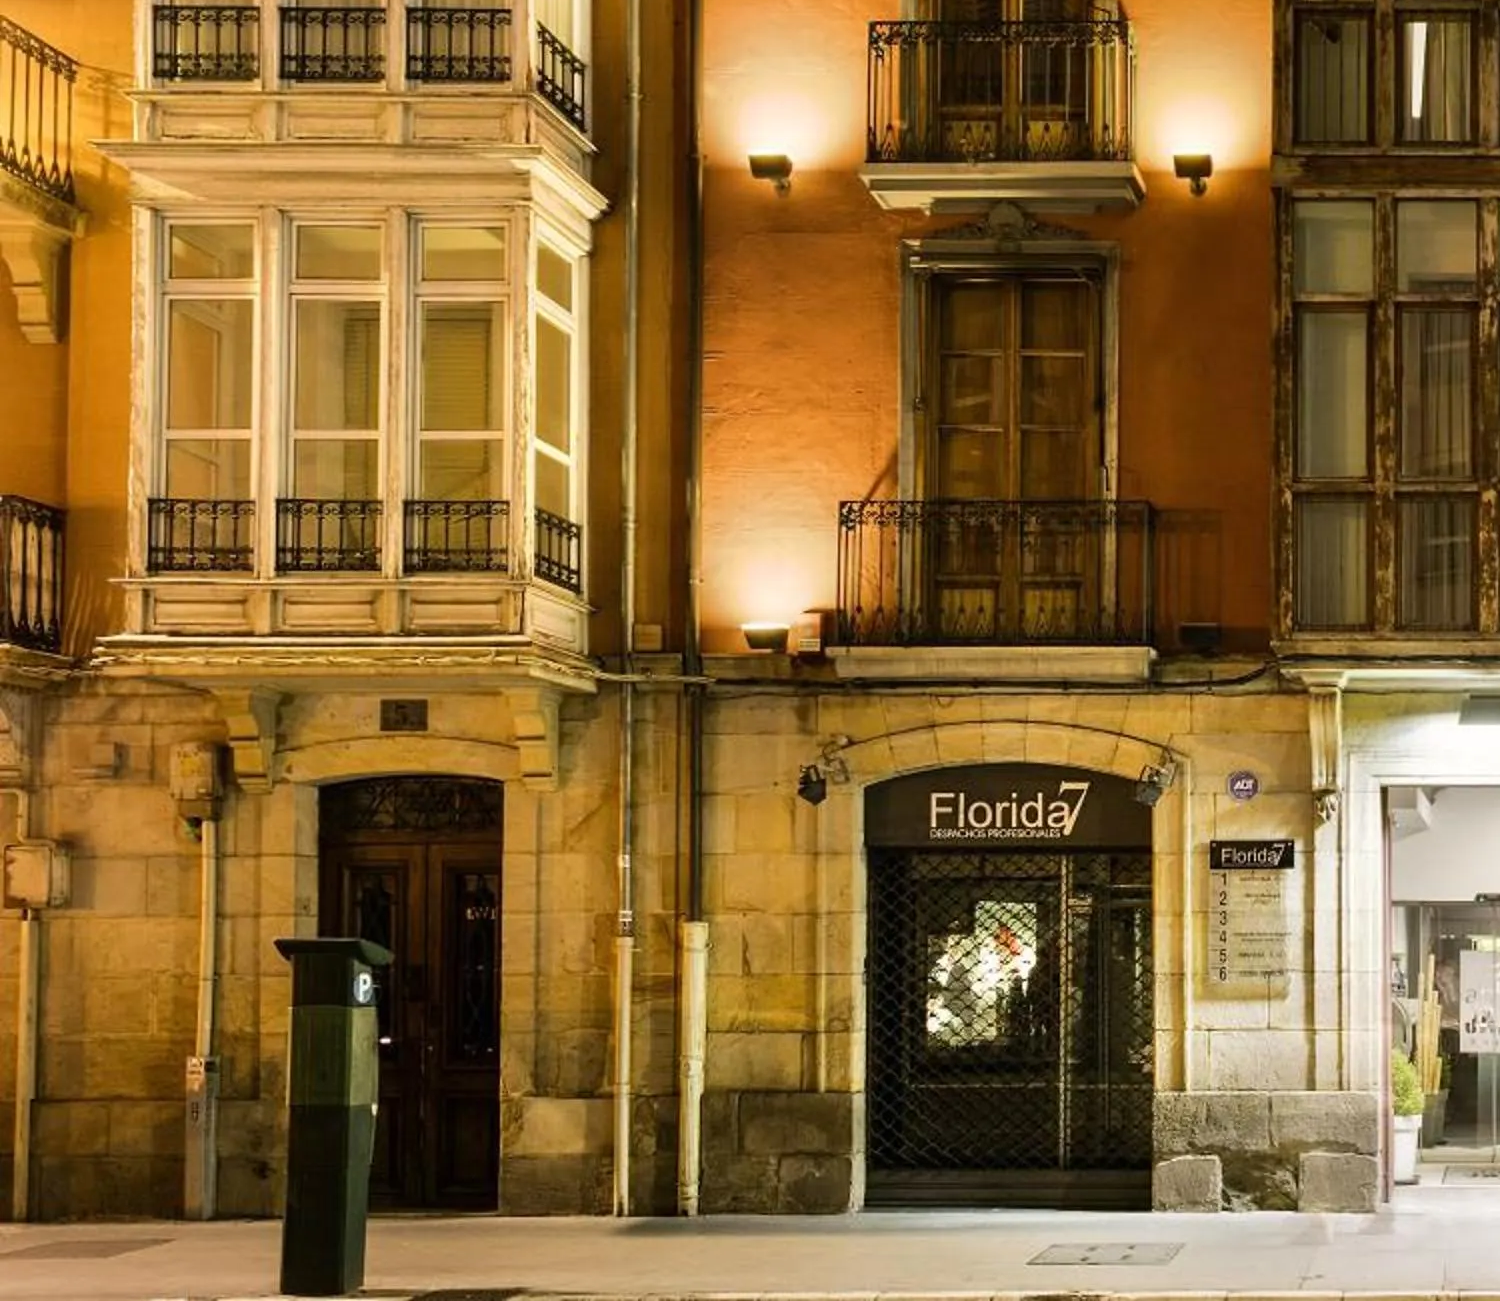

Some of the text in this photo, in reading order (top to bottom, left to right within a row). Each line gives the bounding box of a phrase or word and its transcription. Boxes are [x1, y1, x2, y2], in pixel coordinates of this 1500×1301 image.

[930, 828, 1061, 839] DESPACHOS PROFESIONALES
[1220, 873, 1227, 886] 1
[1219, 891, 1227, 906] 2
[1219, 912, 1227, 926] 3
[1219, 931, 1227, 944] 4
[1219, 949, 1227, 964] 5
[1219, 967, 1227, 982] 6
[359, 972, 371, 1003] P
